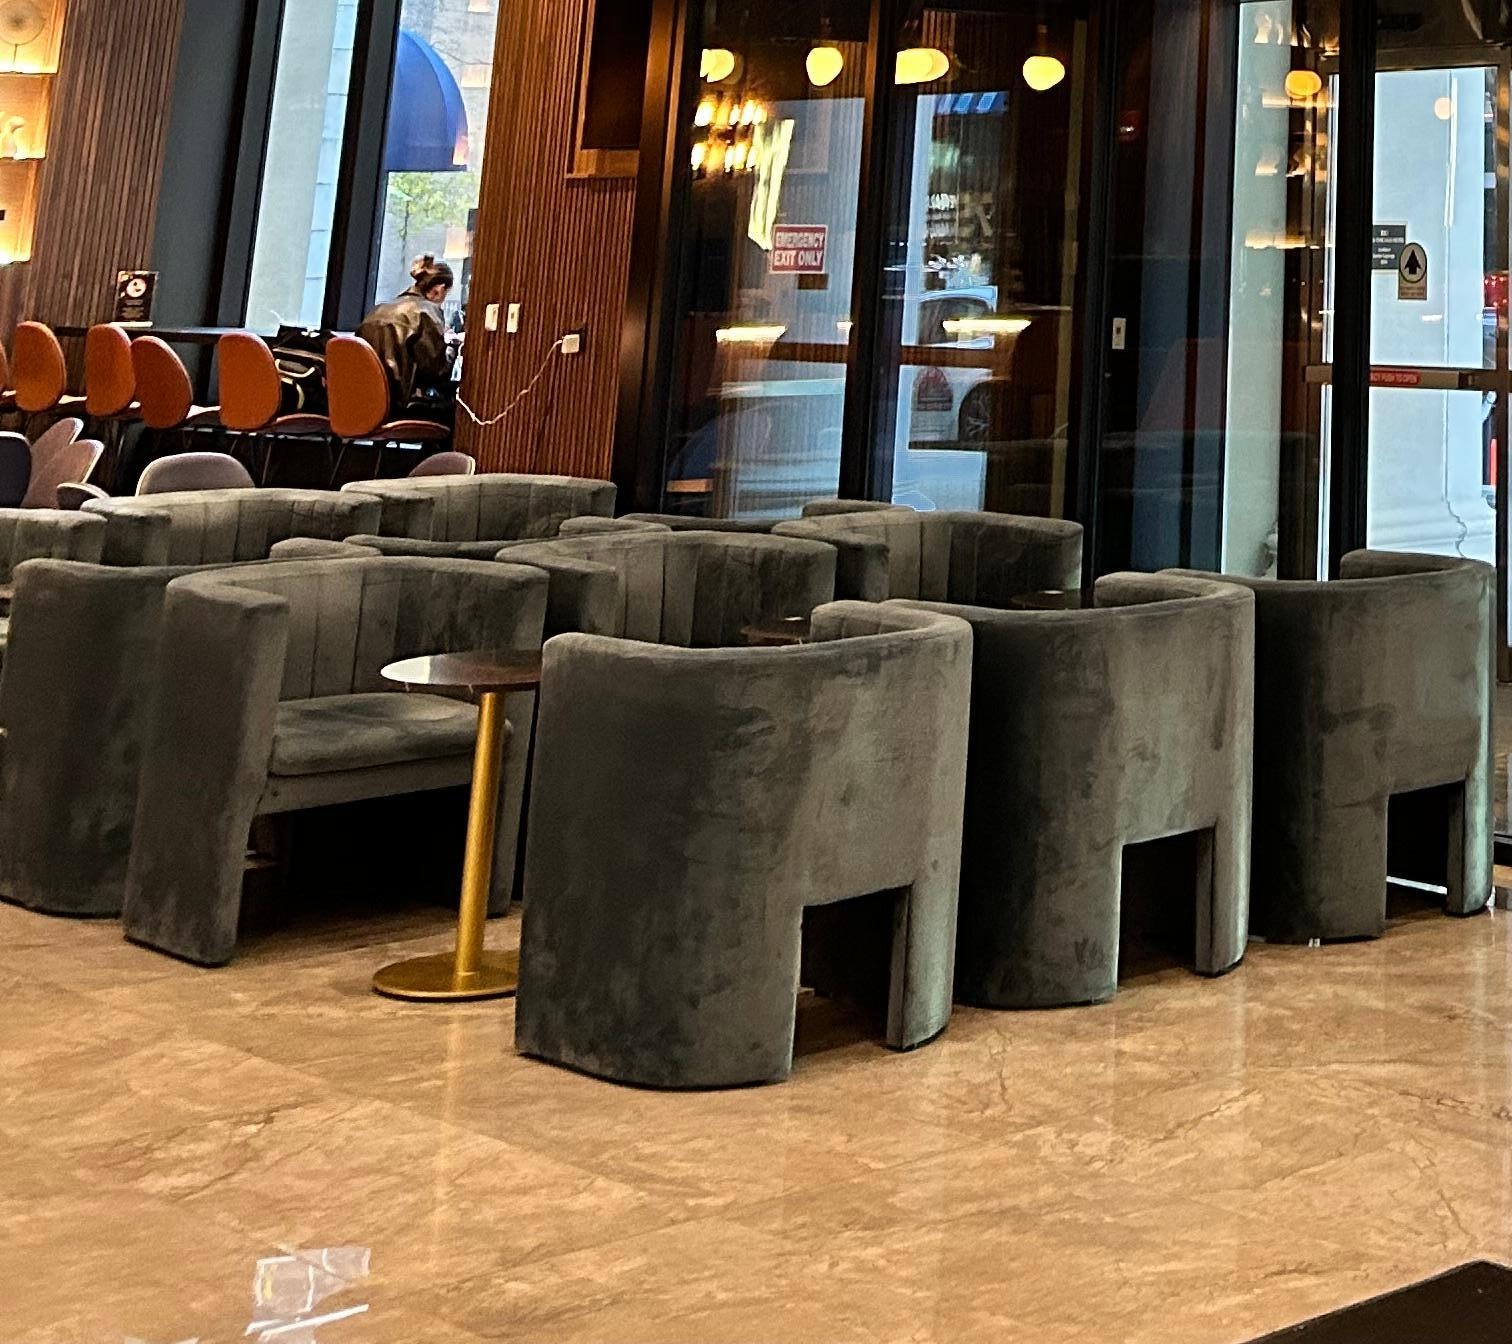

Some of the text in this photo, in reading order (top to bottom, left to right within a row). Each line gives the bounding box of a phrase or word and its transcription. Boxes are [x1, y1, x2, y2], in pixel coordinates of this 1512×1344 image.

[775, 232, 825, 248] EMERGENCY
[774, 250, 823, 266] EXIT ONLY
